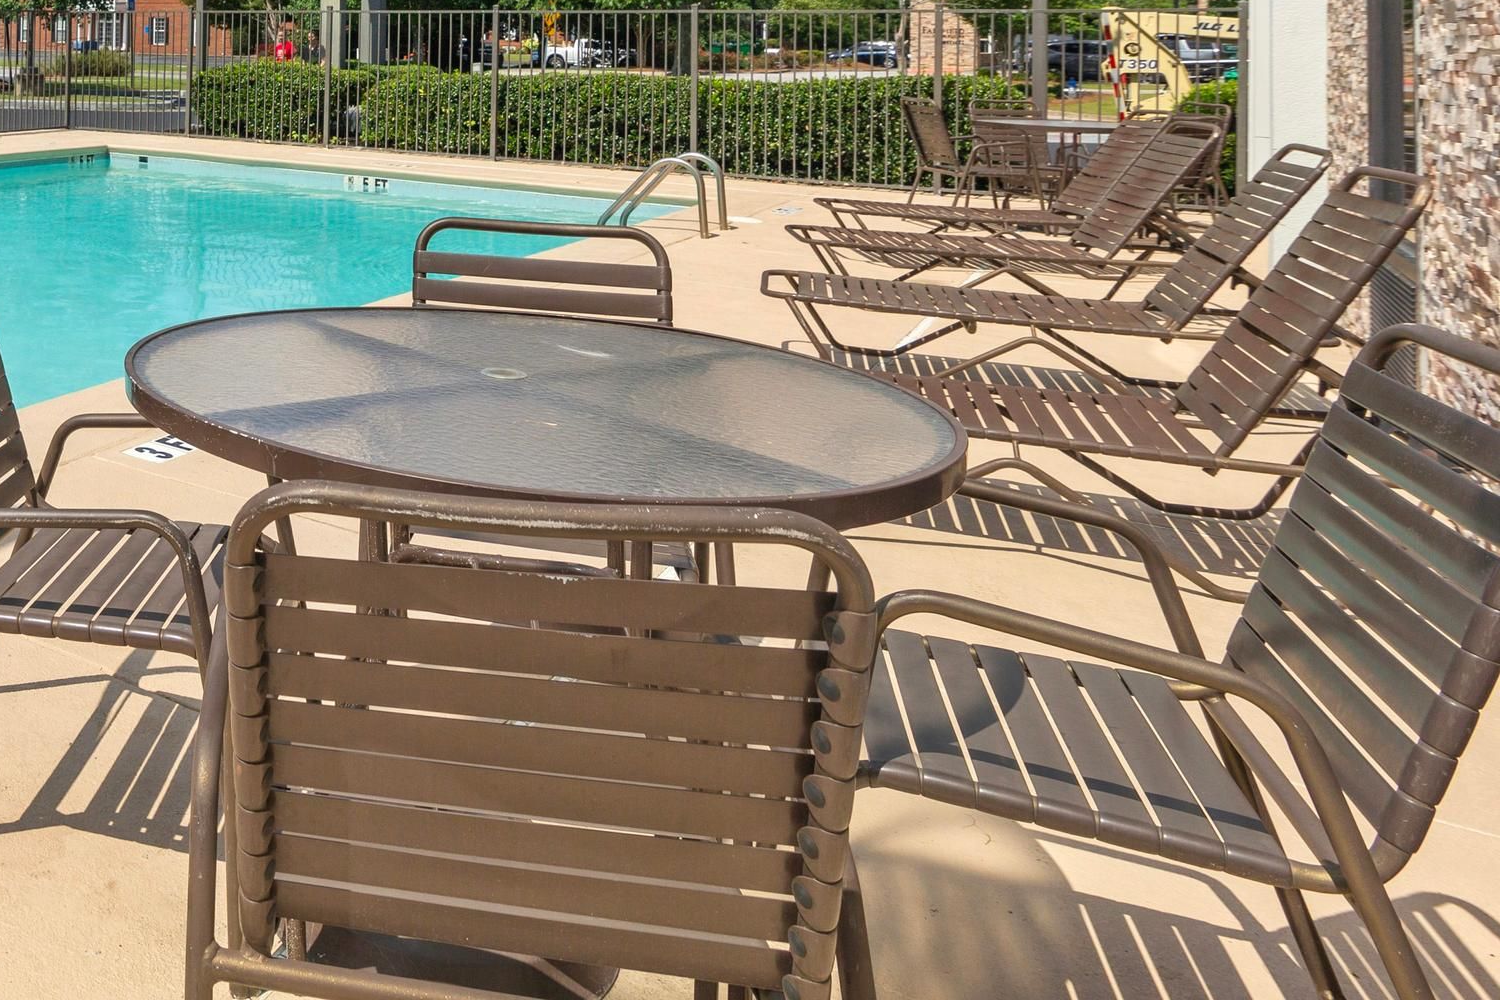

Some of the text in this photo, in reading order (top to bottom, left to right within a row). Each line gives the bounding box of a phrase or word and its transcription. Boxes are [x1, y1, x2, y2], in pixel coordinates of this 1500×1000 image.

[1192, 22, 1223, 31] JLG
[375, 178, 388, 188] FT
[134, 434, 193, 459] 3 F
